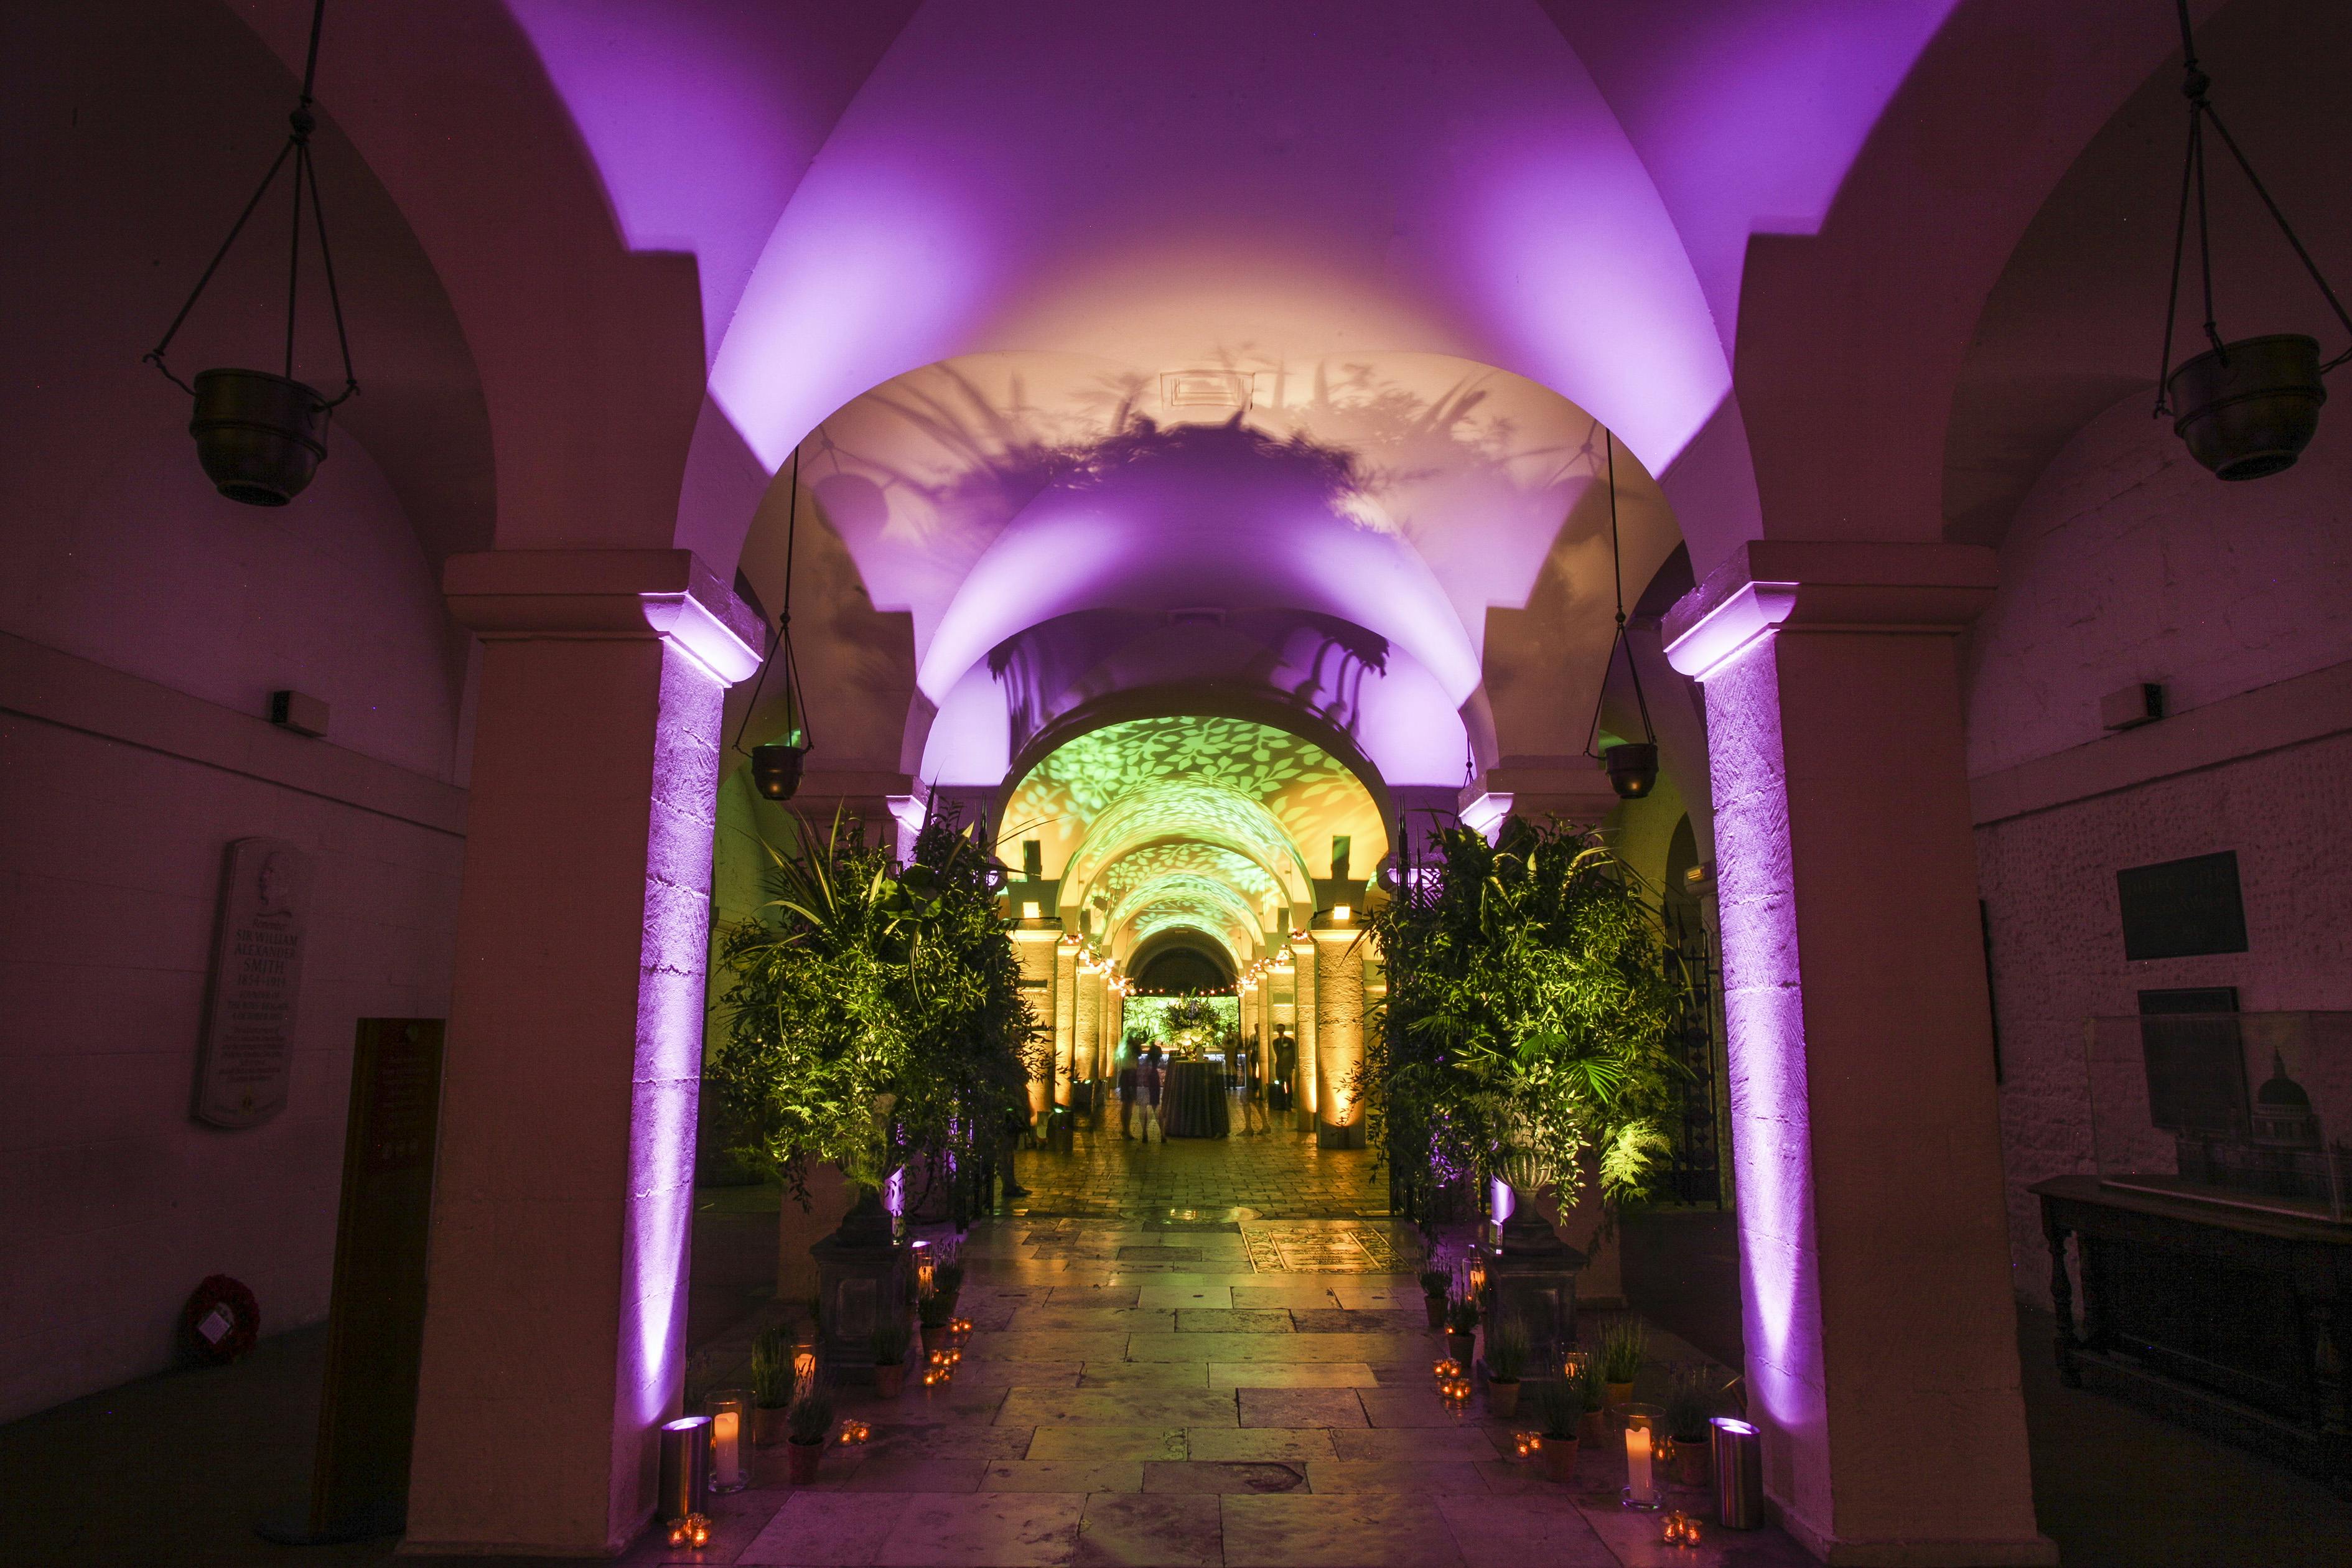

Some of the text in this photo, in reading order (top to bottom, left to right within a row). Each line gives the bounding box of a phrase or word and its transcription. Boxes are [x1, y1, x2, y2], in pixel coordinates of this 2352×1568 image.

[236, 928, 298, 946] SIR WILLIAM
[234, 942, 296, 959] ALEXANDER
[243, 957, 284, 974] SMITH
